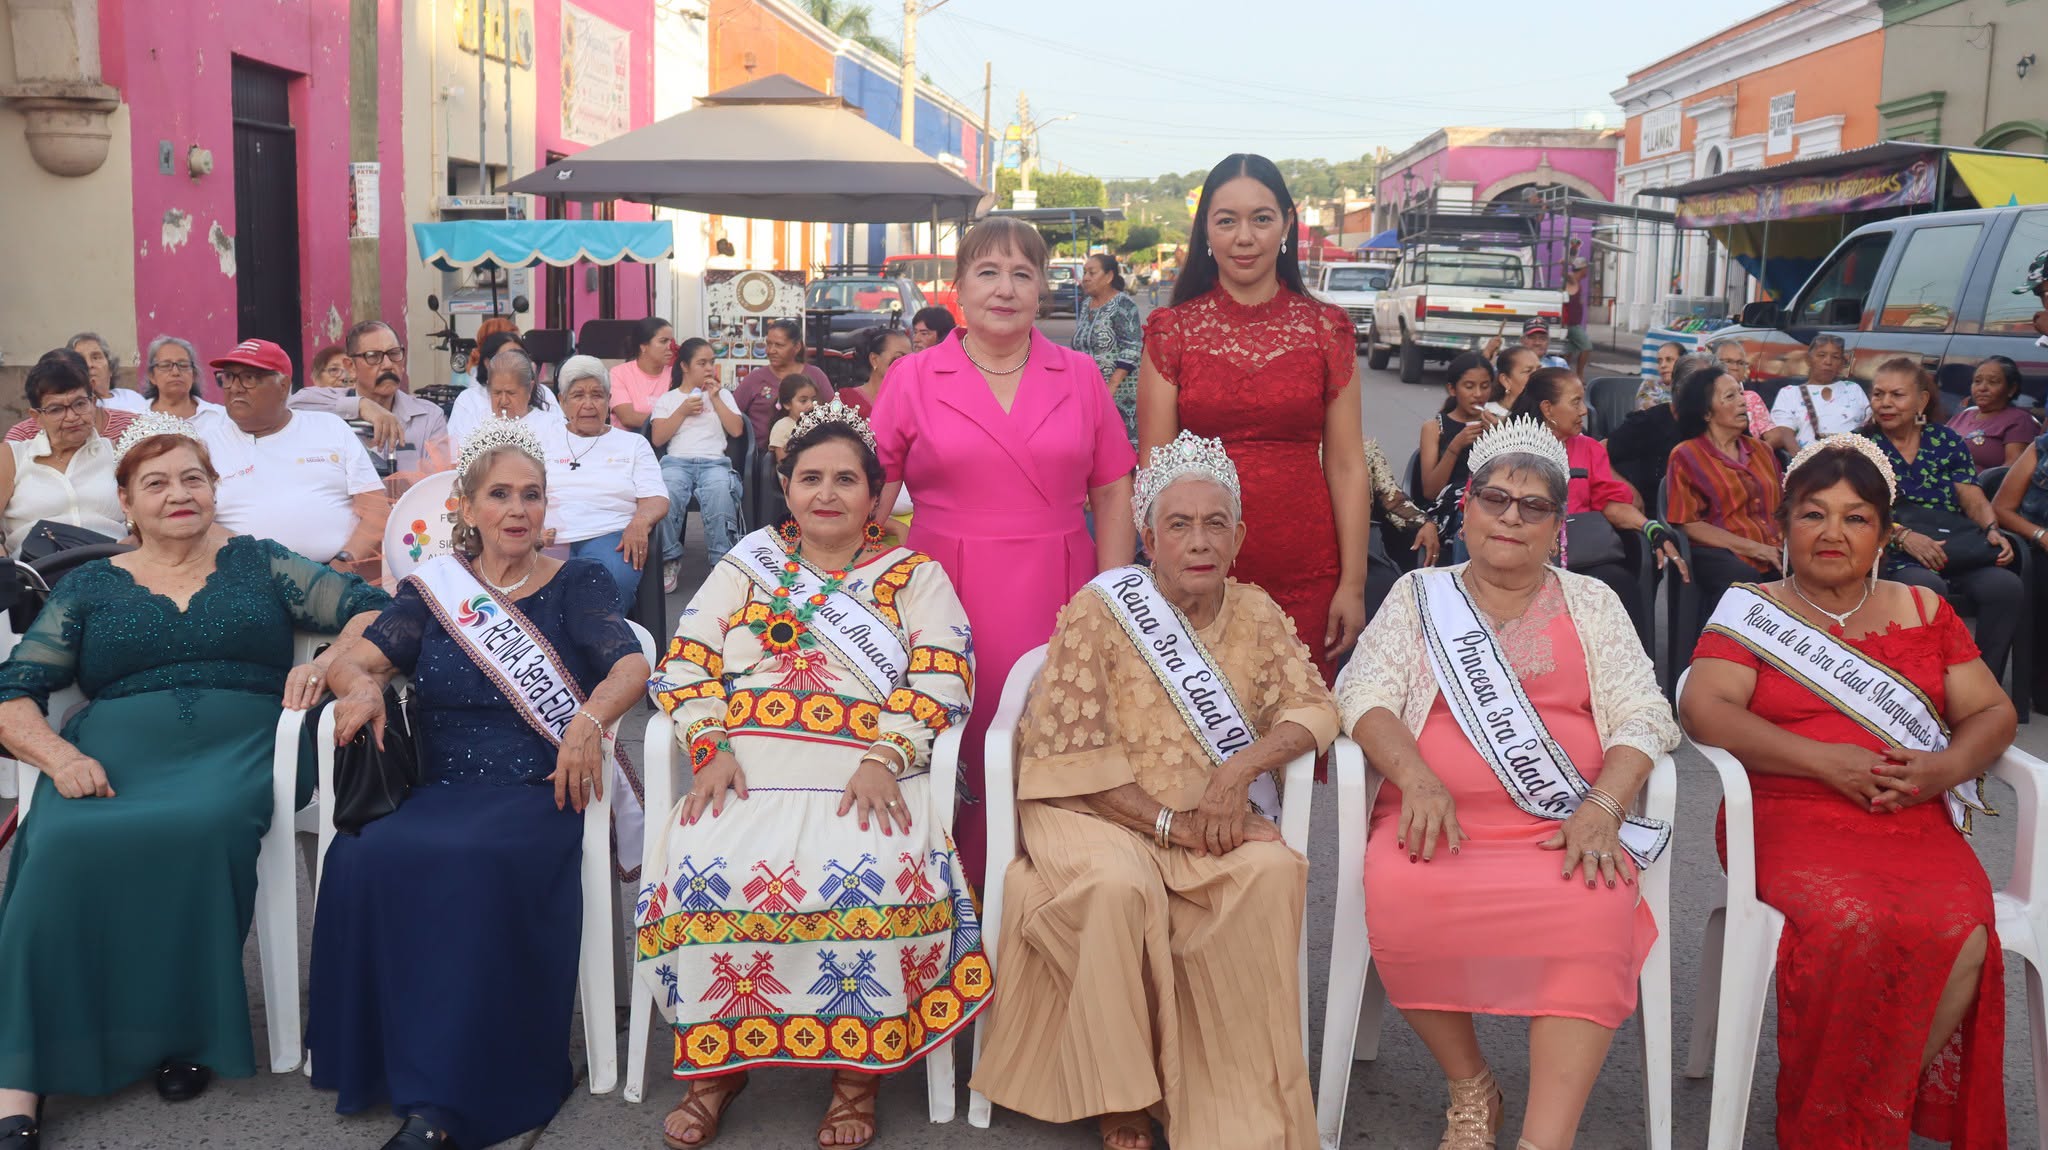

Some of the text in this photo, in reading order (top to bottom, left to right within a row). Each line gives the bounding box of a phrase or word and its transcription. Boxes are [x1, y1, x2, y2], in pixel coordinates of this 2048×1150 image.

[1783, 172, 1901, 204] TOMBOLAS PERRONAS
[479, 618, 576, 739] REINA 3era EDA
[840, 624, 899, 688] Ahuaca
[1112, 573, 1160, 635] Reina
[1154, 633, 1186, 673] 3ra
[1182, 670, 1231, 730] Edad
[1743, 603, 1777, 636] Reina
[1778, 628, 1797, 647] de
[1793, 636, 1810, 657] la
[1809, 645, 1835, 672] 3ra
[1833, 659, 1874, 695] Edad
[1452, 630, 1556, 796] Princesa 3ra Edad
